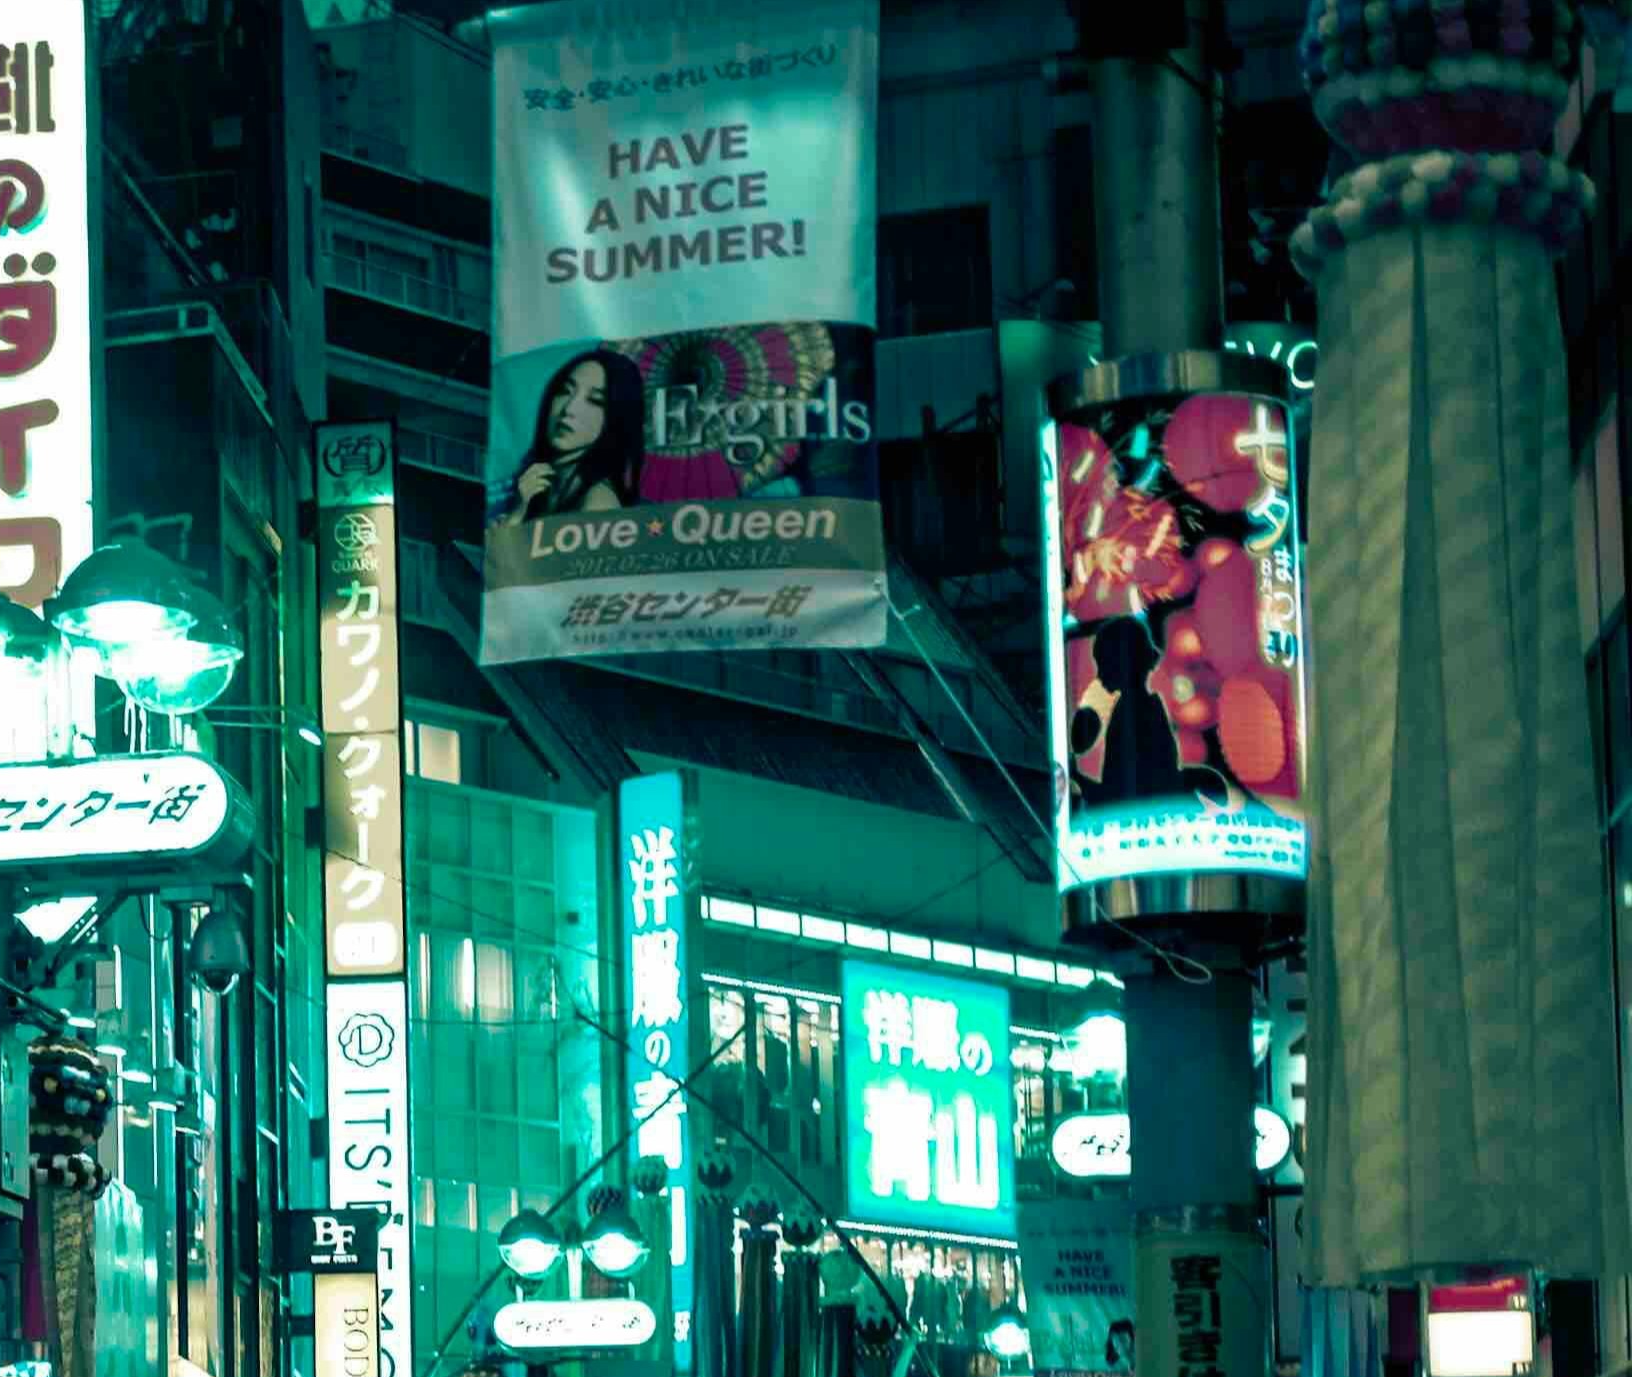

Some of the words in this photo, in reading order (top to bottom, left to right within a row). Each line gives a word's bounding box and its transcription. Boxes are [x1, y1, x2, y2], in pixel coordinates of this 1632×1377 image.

[608, 124, 749, 180] HAVE
[585, 197, 621, 234] A
[635, 171, 768, 224] NICE
[546, 219, 807, 284] SUMMER!
[530, 518, 638, 558] Love
[672, 505, 837, 544] Queen
[560, 585, 813, 627] 渋谷センター街
[336, 581, 385, 911] カワノ・クォーク
